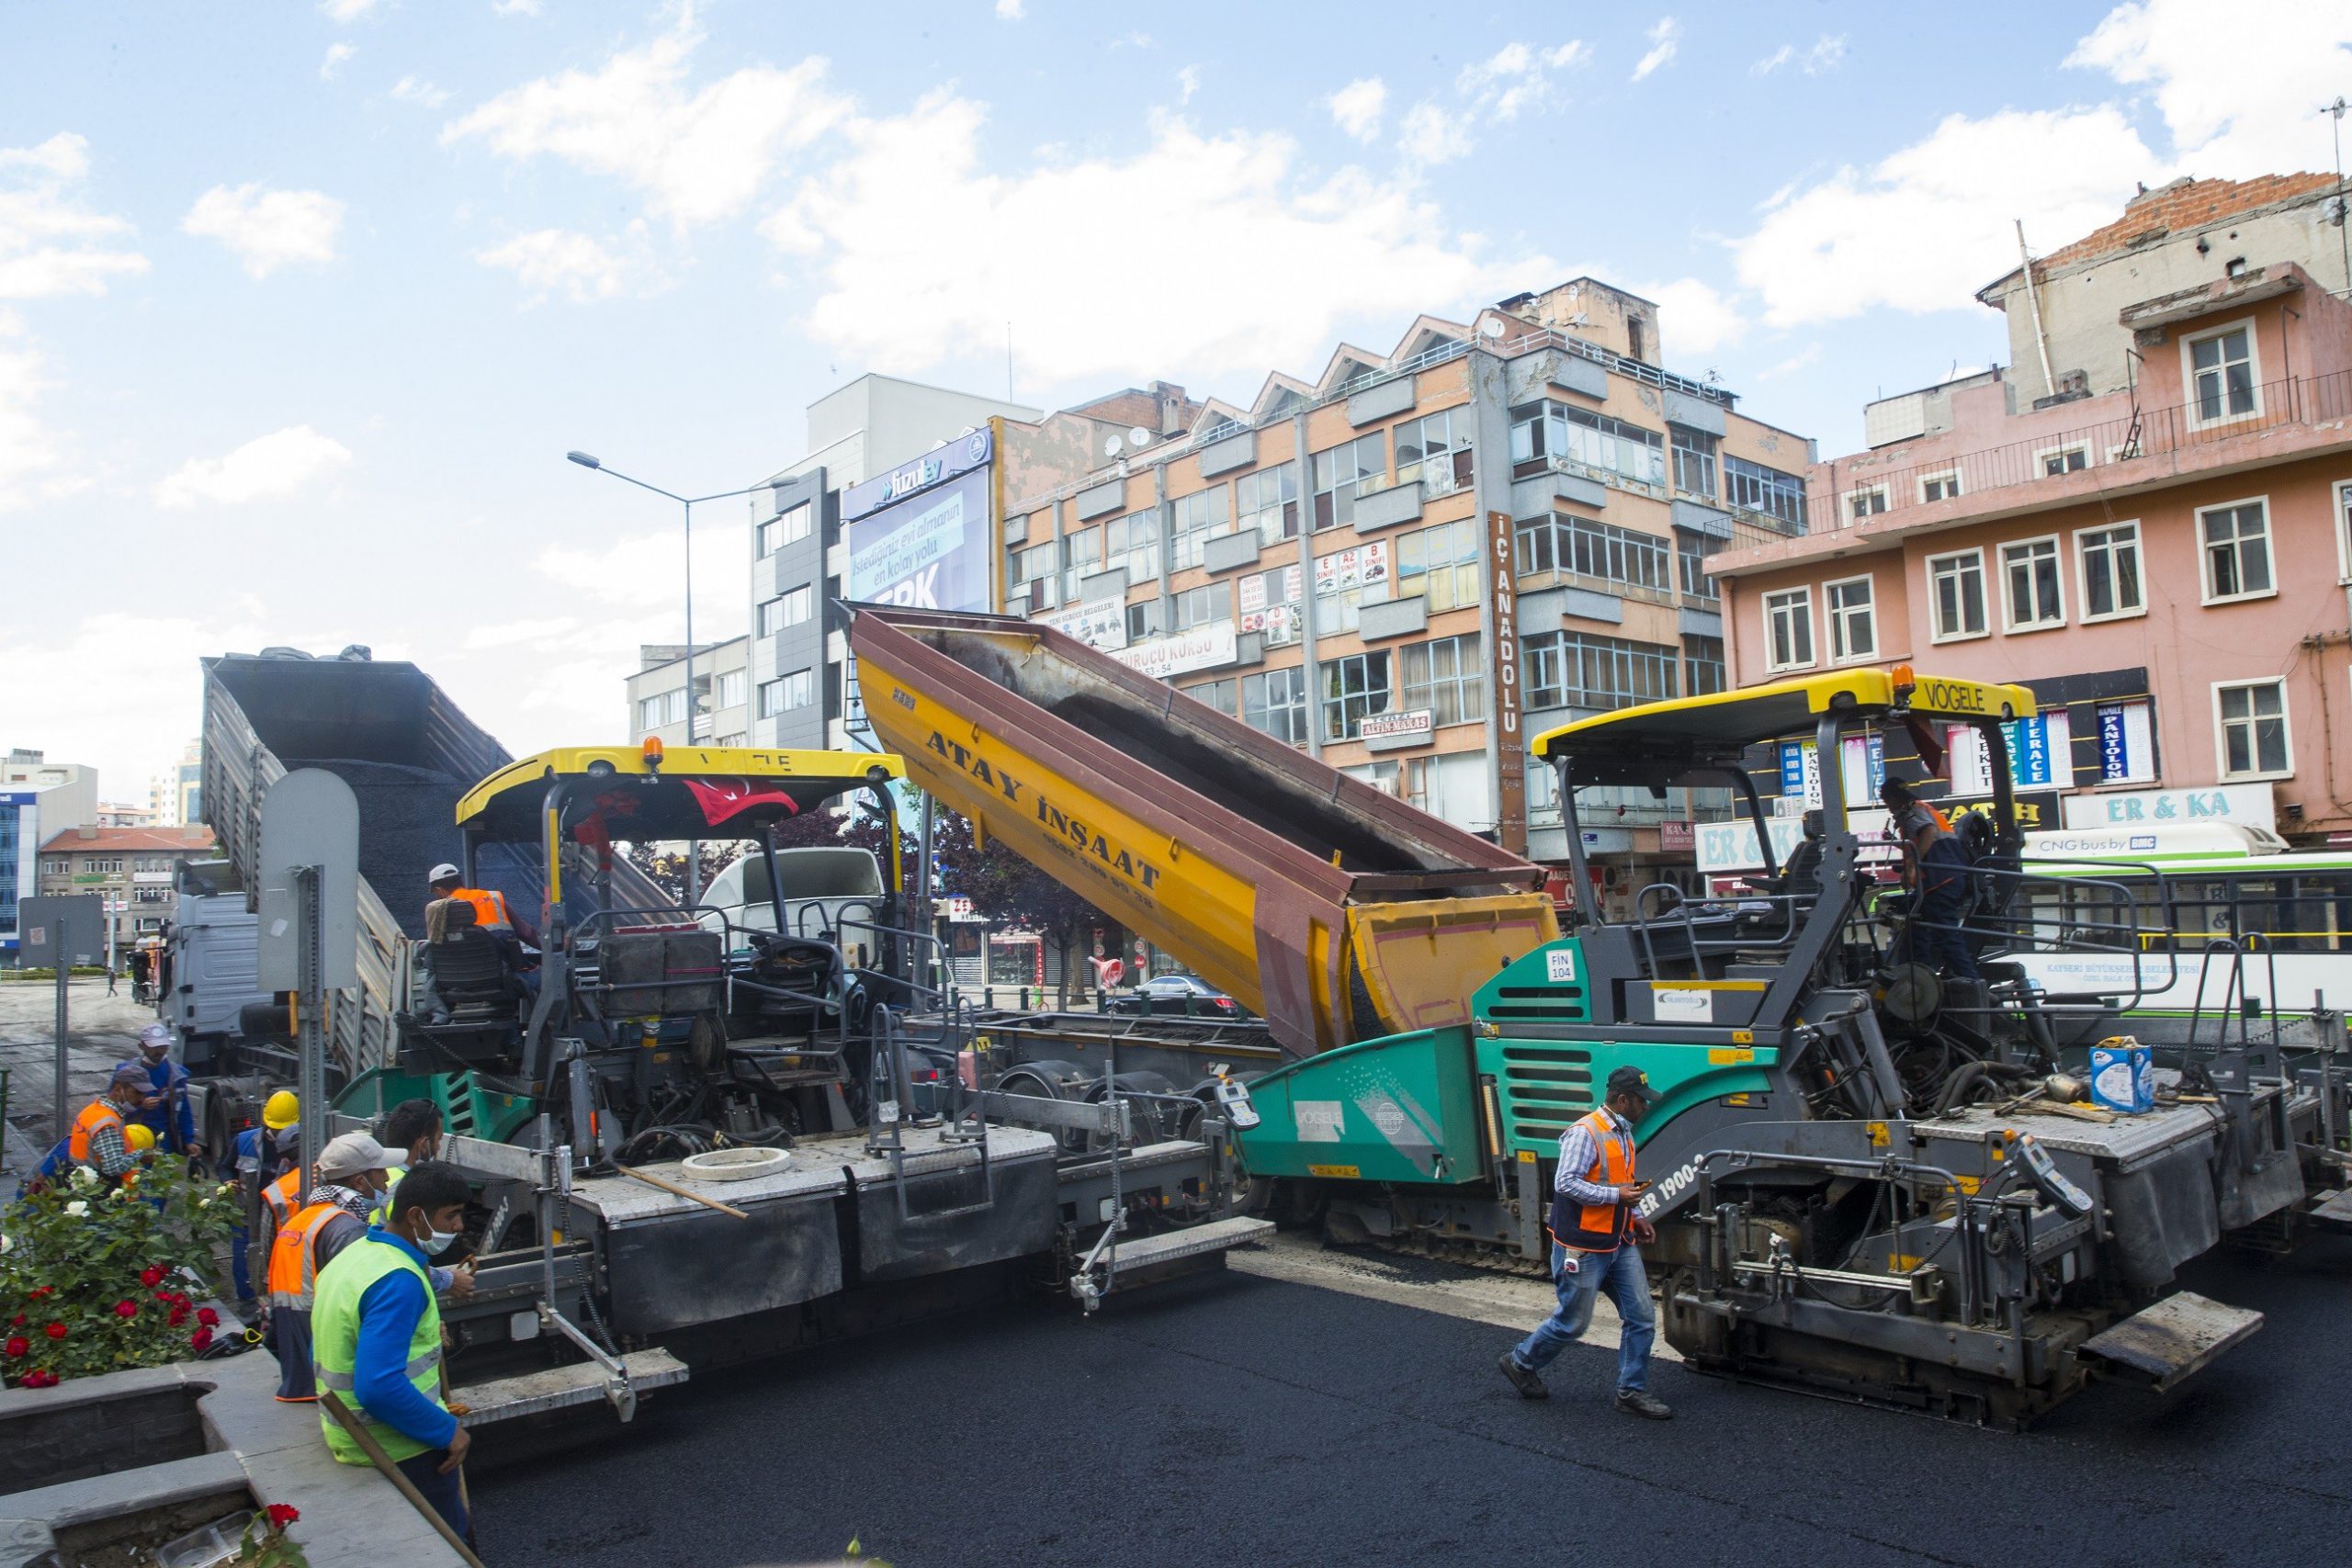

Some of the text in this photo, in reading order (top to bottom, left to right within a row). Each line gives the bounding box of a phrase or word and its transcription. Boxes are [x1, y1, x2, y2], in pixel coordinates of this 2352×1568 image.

[1343, 552, 1354, 563] A2
[1371, 545, 1378, 557] B
[874, 536, 938, 586] en kolay yolu
[1323, 558, 1329, 569] E
[1341, 562, 1358, 572] SINIFI
[1365, 556, 1385, 567] SINIFI
[1317, 570, 1336, 580] SINIFI
[1274, 607, 1280, 617] D
[1498, 570, 1516, 733] ANADOLU
[1924, 679, 1984, 711] VÖGELE
[2029, 717, 2043, 783] FERACE
[2104, 716, 2122, 779] PANTOLON
[926, 730, 1023, 803] ATAY
[1808, 752, 1820, 805] PANTOLON
[1939, 802, 2040, 825] ATH
[2107, 792, 2231, 822] ER & KA
[1036, 795, 1159, 890] İNŞAAT
[1704, 829, 1738, 865] ER
[1744, 829, 1764, 862] &
[2040, 837, 2155, 852] CNG bus by BMC
[1552, 953, 1568, 964] FİN
[1553, 968, 1571, 978] 104
[2047, 963, 2200, 974] KAYSERİ BÜYÜKŞEHR BELEYESİ
[2125, 974, 2159, 983] OTBÜSÜ
